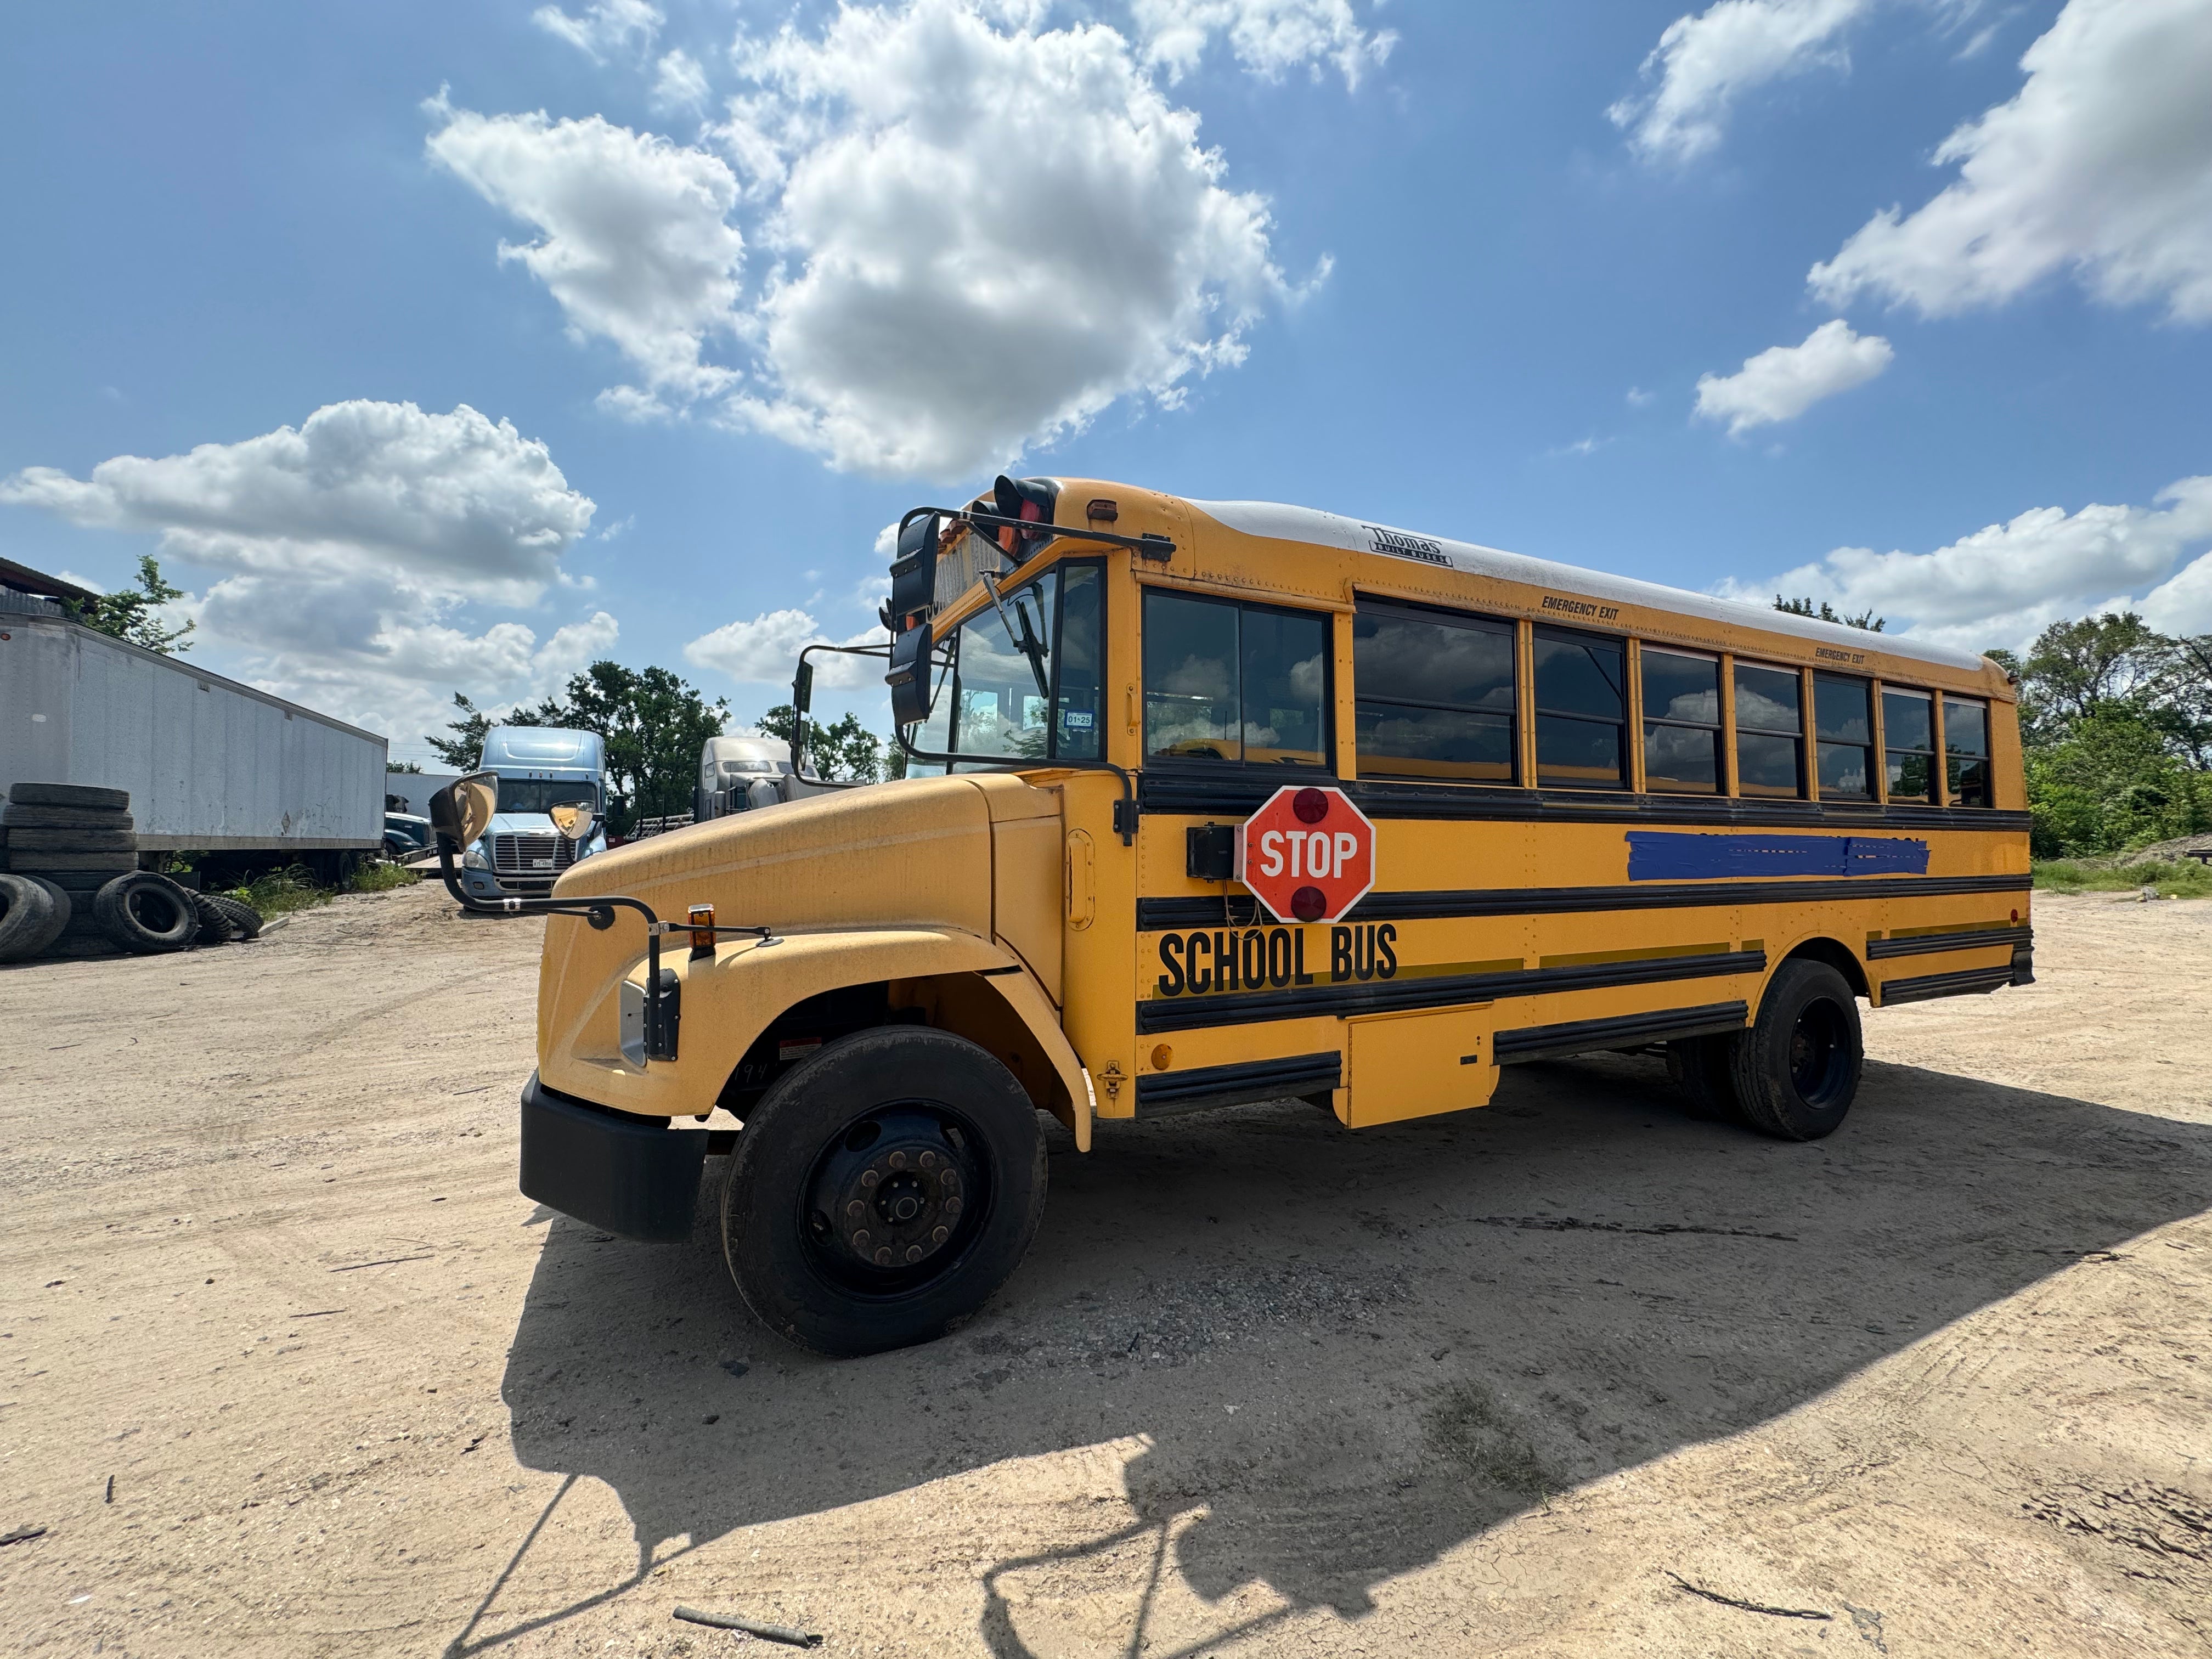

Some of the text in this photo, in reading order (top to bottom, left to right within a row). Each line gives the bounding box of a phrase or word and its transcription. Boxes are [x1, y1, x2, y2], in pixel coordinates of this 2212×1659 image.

[1361, 525, 1442, 554] Thomas
[1378, 544, 1444, 562] BUILT BUSES
[1542, 596, 1619, 620] EMERGENCY EXIT
[1815, 647, 1865, 664] EMERGENCY EXIT
[1260, 830, 1358, 878] STOP
[1159, 923, 1397, 997] SCHOOL BUS
